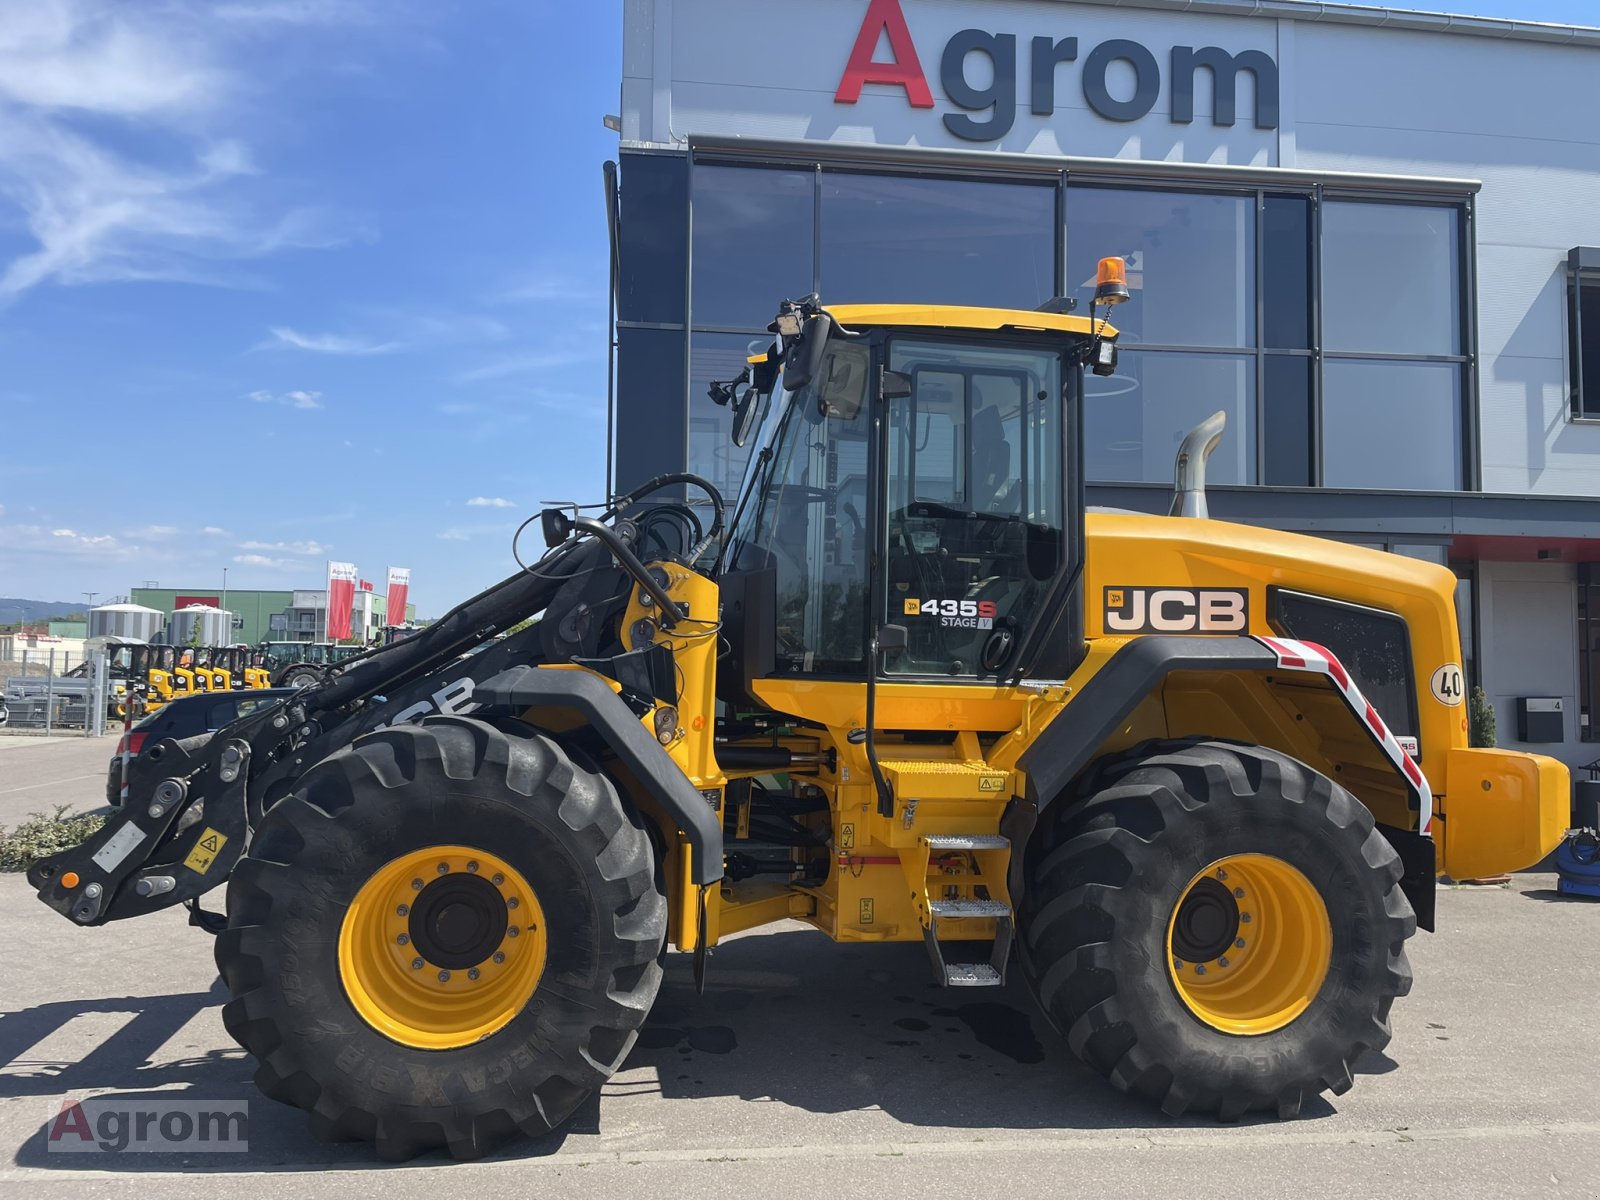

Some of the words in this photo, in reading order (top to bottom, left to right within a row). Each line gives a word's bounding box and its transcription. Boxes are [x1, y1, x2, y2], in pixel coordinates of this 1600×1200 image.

[834, 0, 1279, 142] Agrom
[921, 599, 997, 617] 435S
[1108, 590, 1246, 630] JCB
[941, 617, 977, 628] STAGE
[1441, 672, 1461, 697] 40
[374, 677, 480, 731] CB
[1555, 701, 1561, 710] 4
